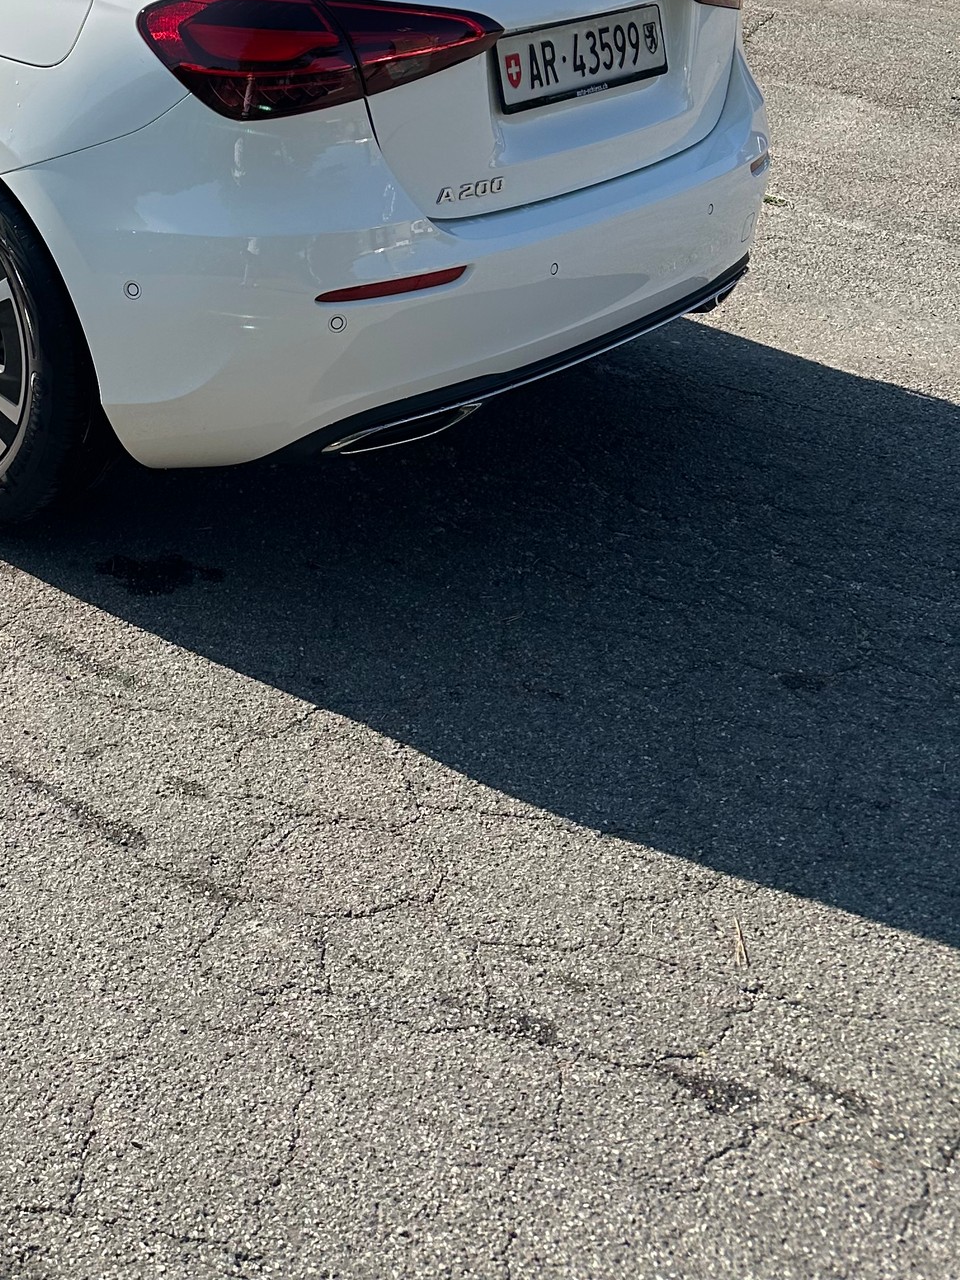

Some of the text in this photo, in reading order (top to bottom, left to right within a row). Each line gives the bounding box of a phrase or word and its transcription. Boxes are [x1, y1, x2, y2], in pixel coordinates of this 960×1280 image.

[528, 22, 640, 90] AR 43599
[436, 176, 505, 205] A 200
